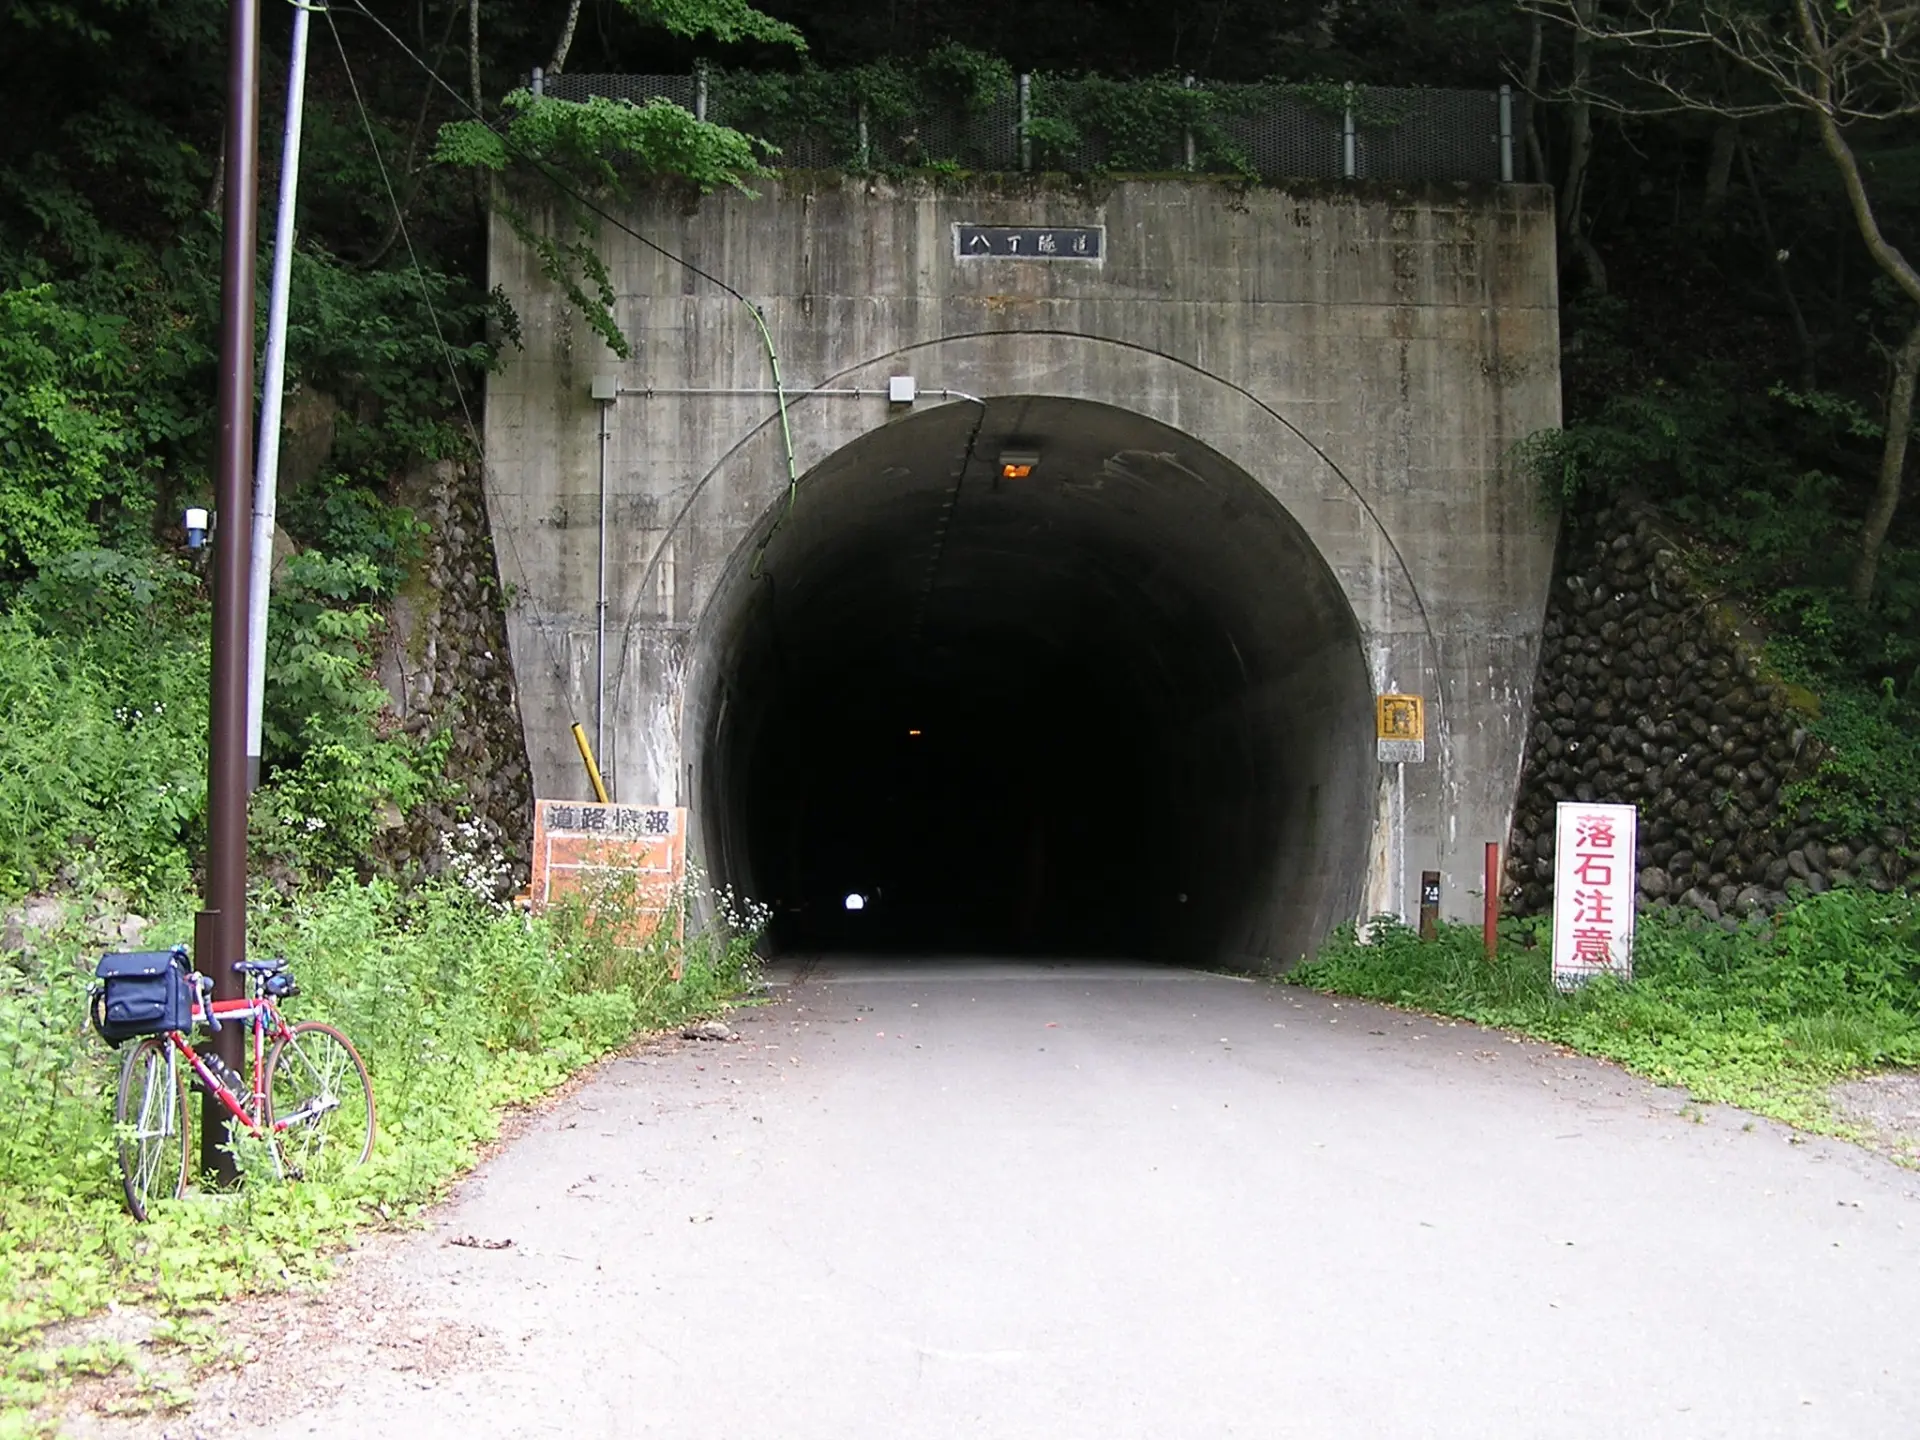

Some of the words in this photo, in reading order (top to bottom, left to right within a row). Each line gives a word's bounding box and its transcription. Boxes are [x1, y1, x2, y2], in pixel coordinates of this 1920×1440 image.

[549, 804, 670, 833] 道路情報
[1572, 814, 1615, 963] 落石注意
